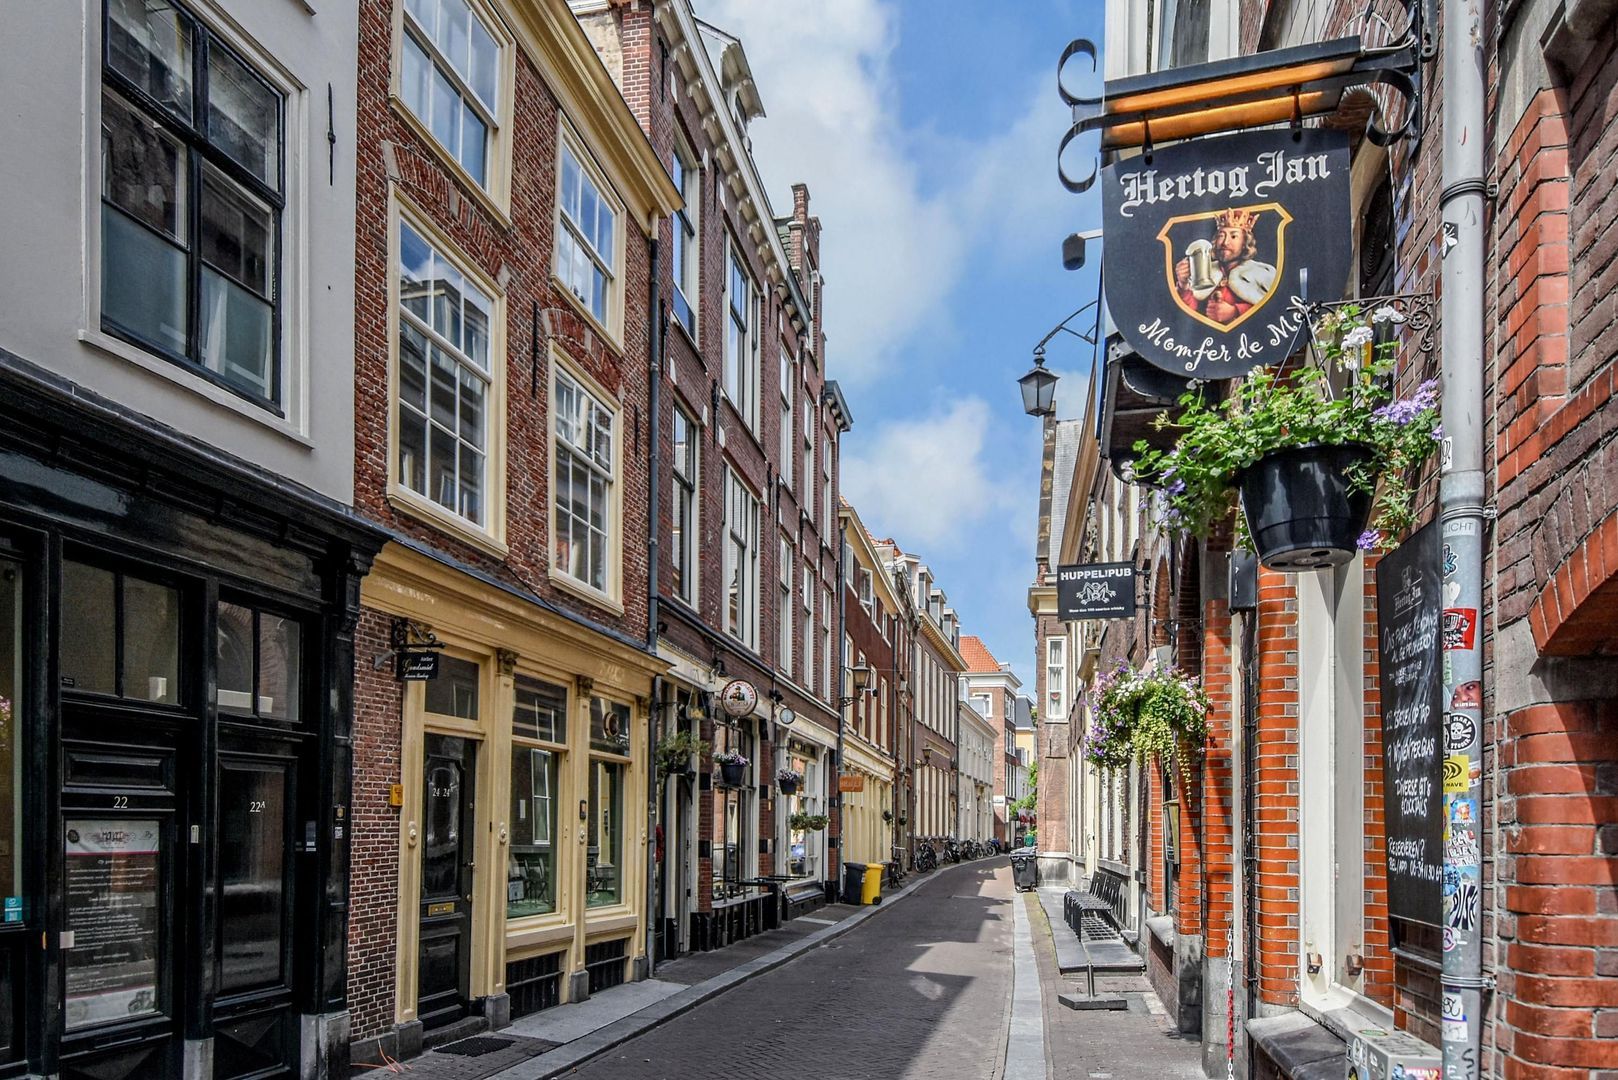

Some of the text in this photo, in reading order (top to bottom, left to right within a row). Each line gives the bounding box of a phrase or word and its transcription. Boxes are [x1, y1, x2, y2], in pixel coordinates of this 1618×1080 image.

[1120, 150, 1331, 217] Hertog Jan
[1138, 317, 1231, 372] Momfer
[1237, 333, 1263, 359] de
[432, 787, 440, 797] 24
[113, 796, 128, 809] 22
[250, 801, 265, 813] 22A
